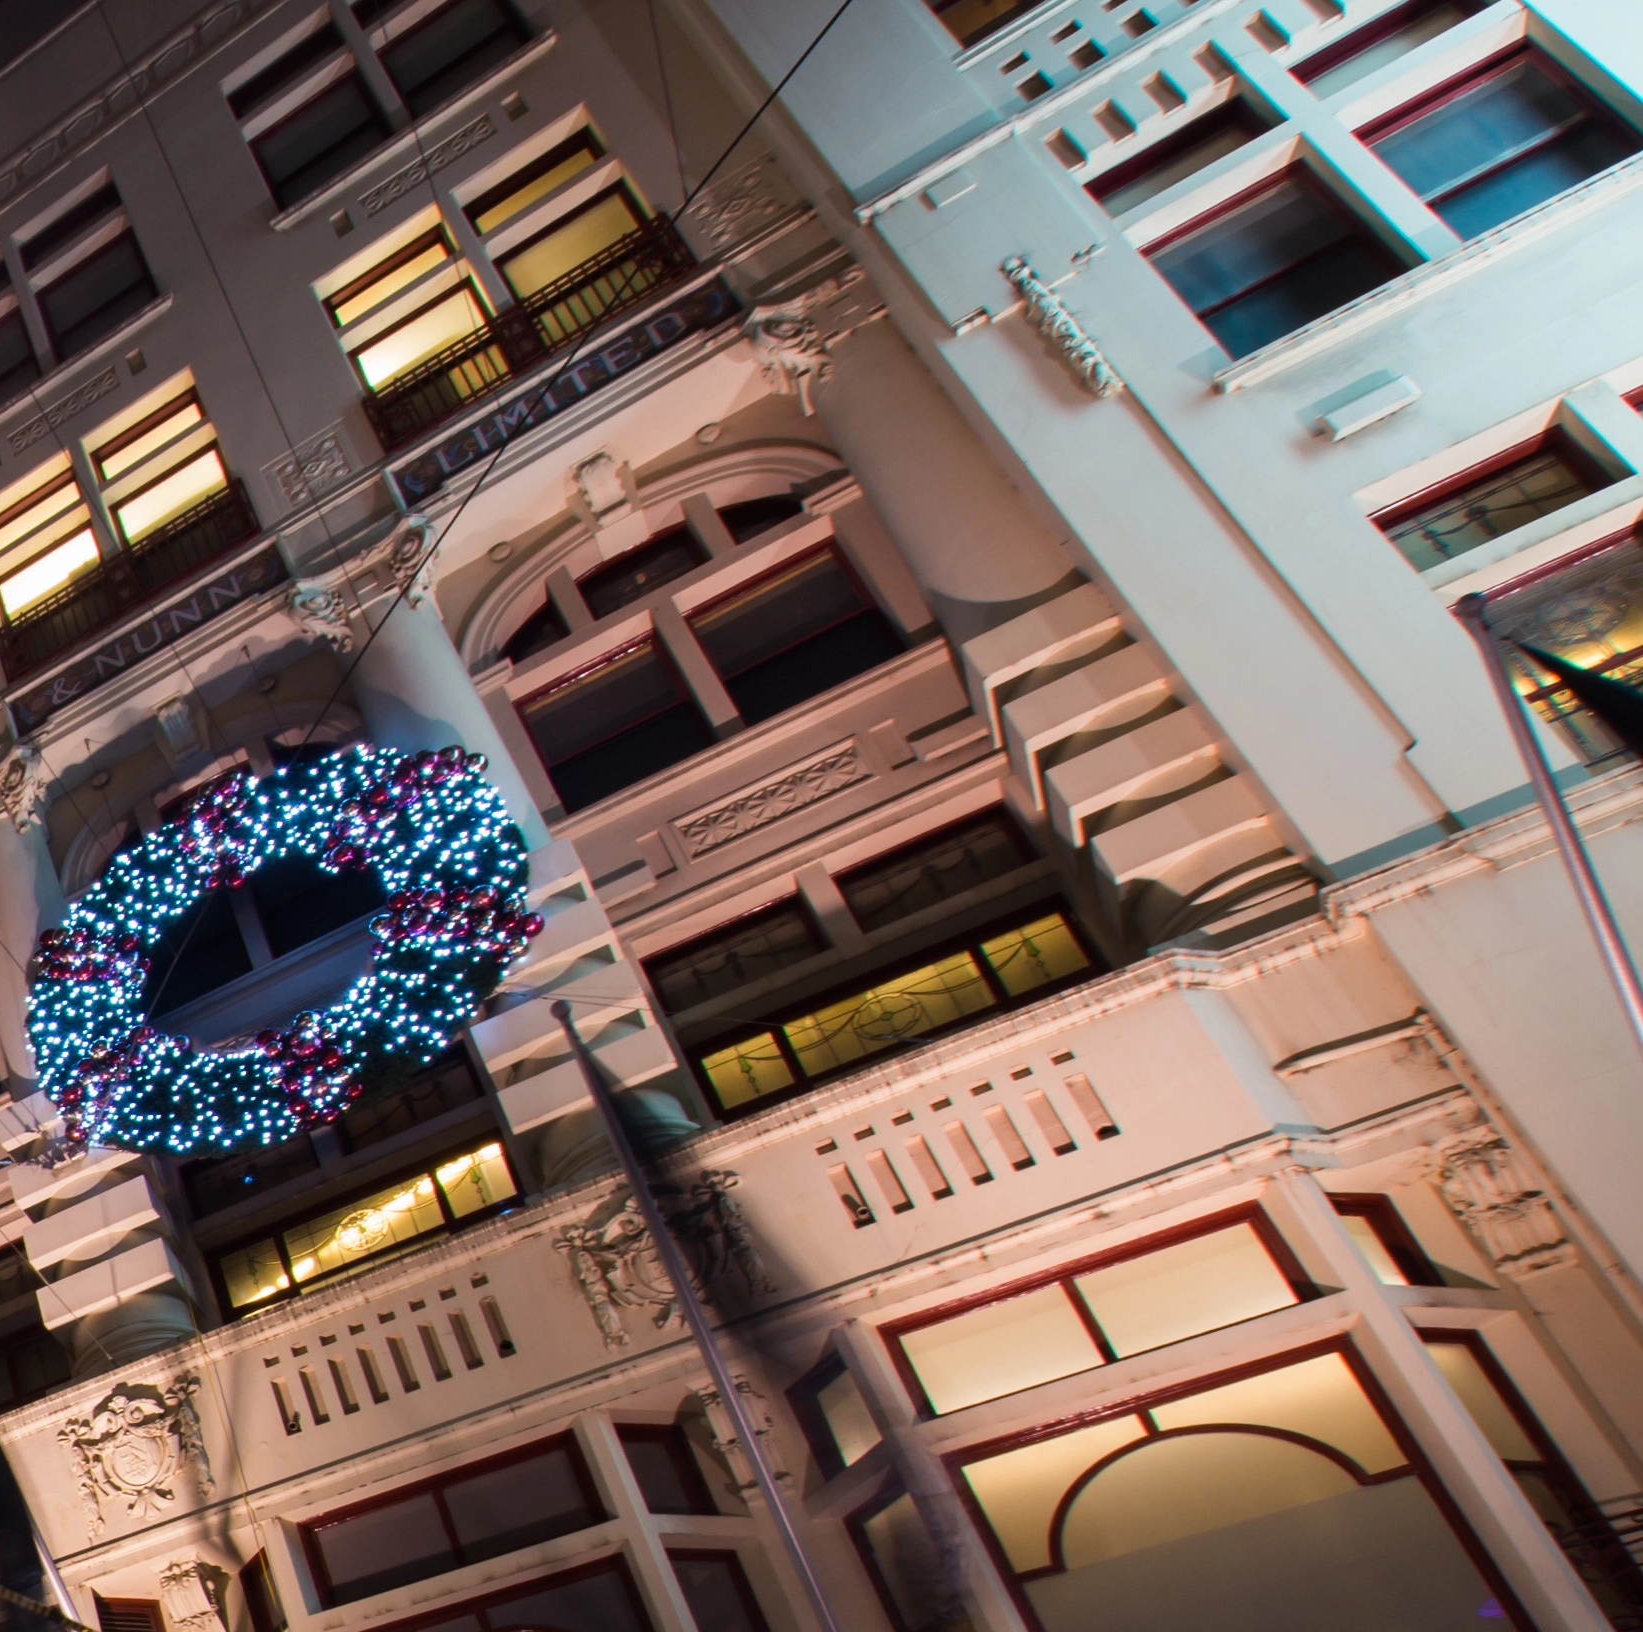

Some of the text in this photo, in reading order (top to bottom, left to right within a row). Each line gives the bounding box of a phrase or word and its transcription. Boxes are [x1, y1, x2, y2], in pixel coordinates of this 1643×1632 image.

[51, 678, 82, 704] &
[92, 573, 245, 678] NUNN
[435, 312, 685, 473] LIMITED
